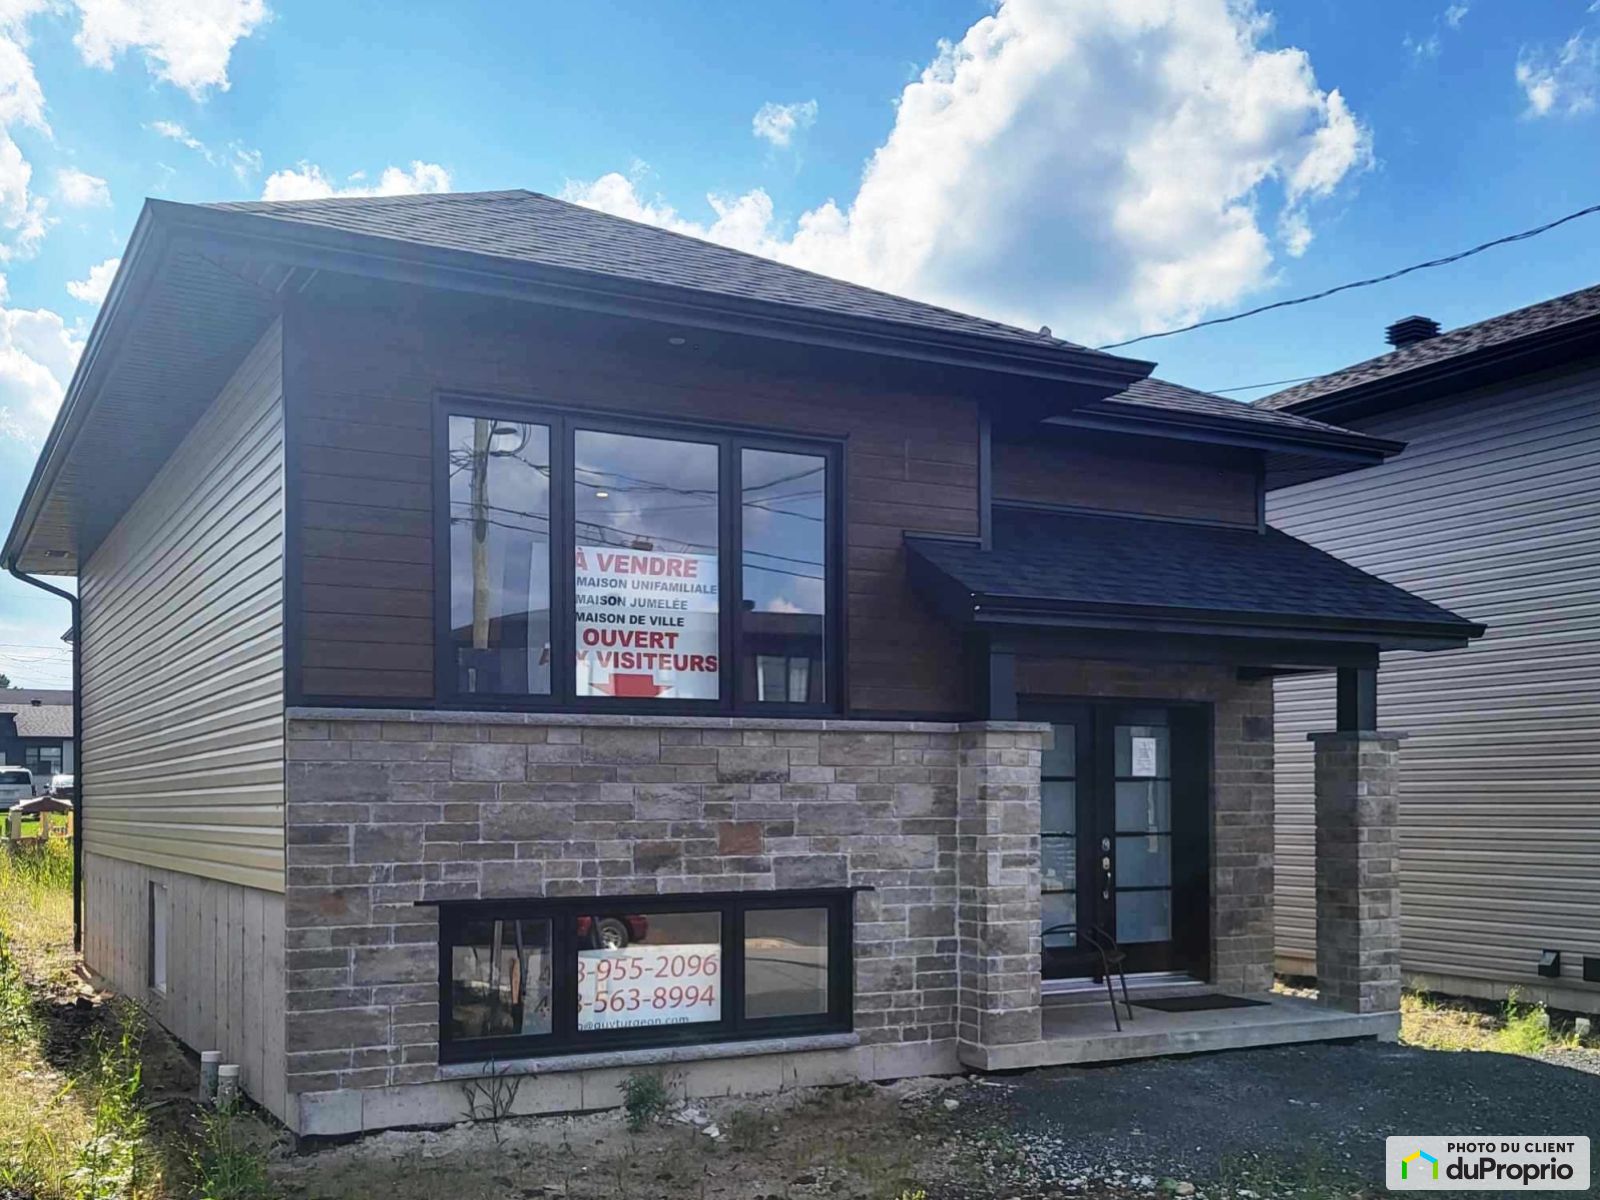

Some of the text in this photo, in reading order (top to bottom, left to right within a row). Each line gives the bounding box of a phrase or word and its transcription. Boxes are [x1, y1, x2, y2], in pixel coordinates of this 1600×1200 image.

[576, 547, 698, 578] À VENDRE
[576, 576, 718, 595] MAISON UNIFAMILIALE
[575, 594, 688, 611] MAISON JUMELÉE
[575, 611, 685, 627] MAISON DE VILLE
[582, 628, 679, 650] OUVERT
[597, 651, 718, 673] VISITEURS
